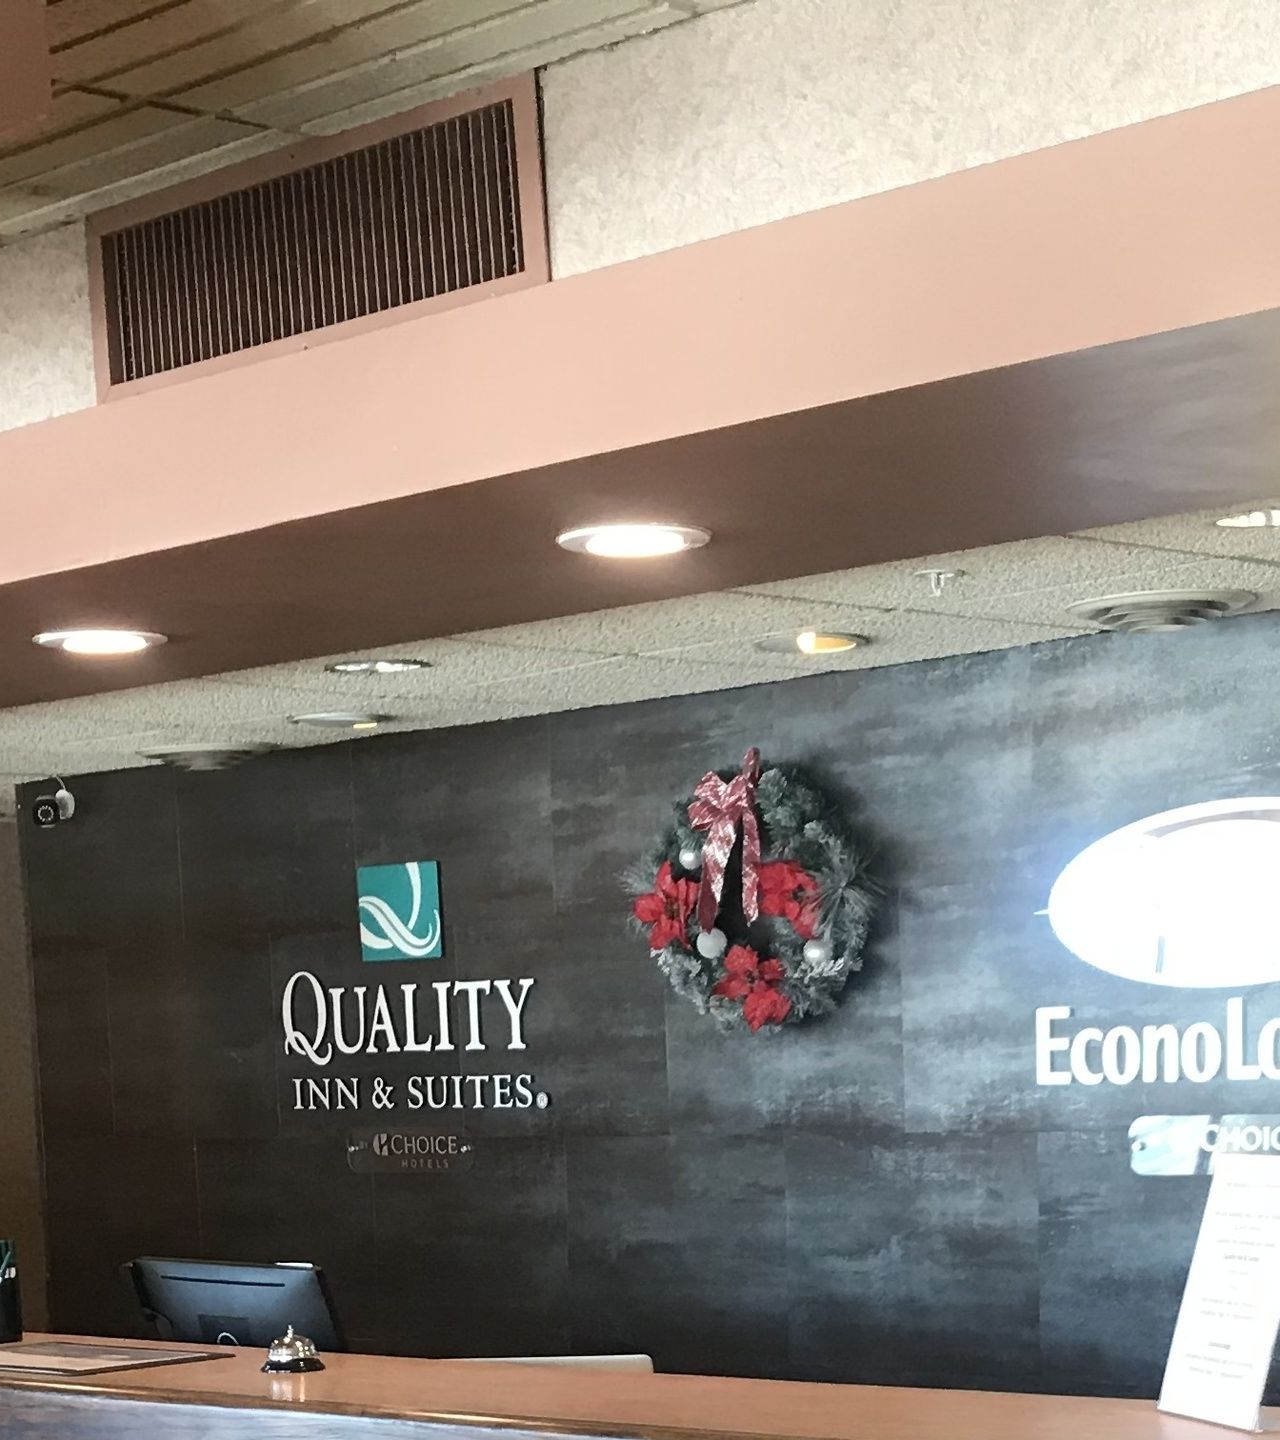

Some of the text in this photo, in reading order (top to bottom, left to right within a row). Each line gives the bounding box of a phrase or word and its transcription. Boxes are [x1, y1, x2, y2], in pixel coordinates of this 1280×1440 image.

[282, 971, 535, 1066] QUALITY
[292, 1077, 359, 1110] INN
[371, 1076, 395, 1110] &
[391, 1134, 458, 1155] CHOICE
[401, 1158, 449, 1169] HOTELS
